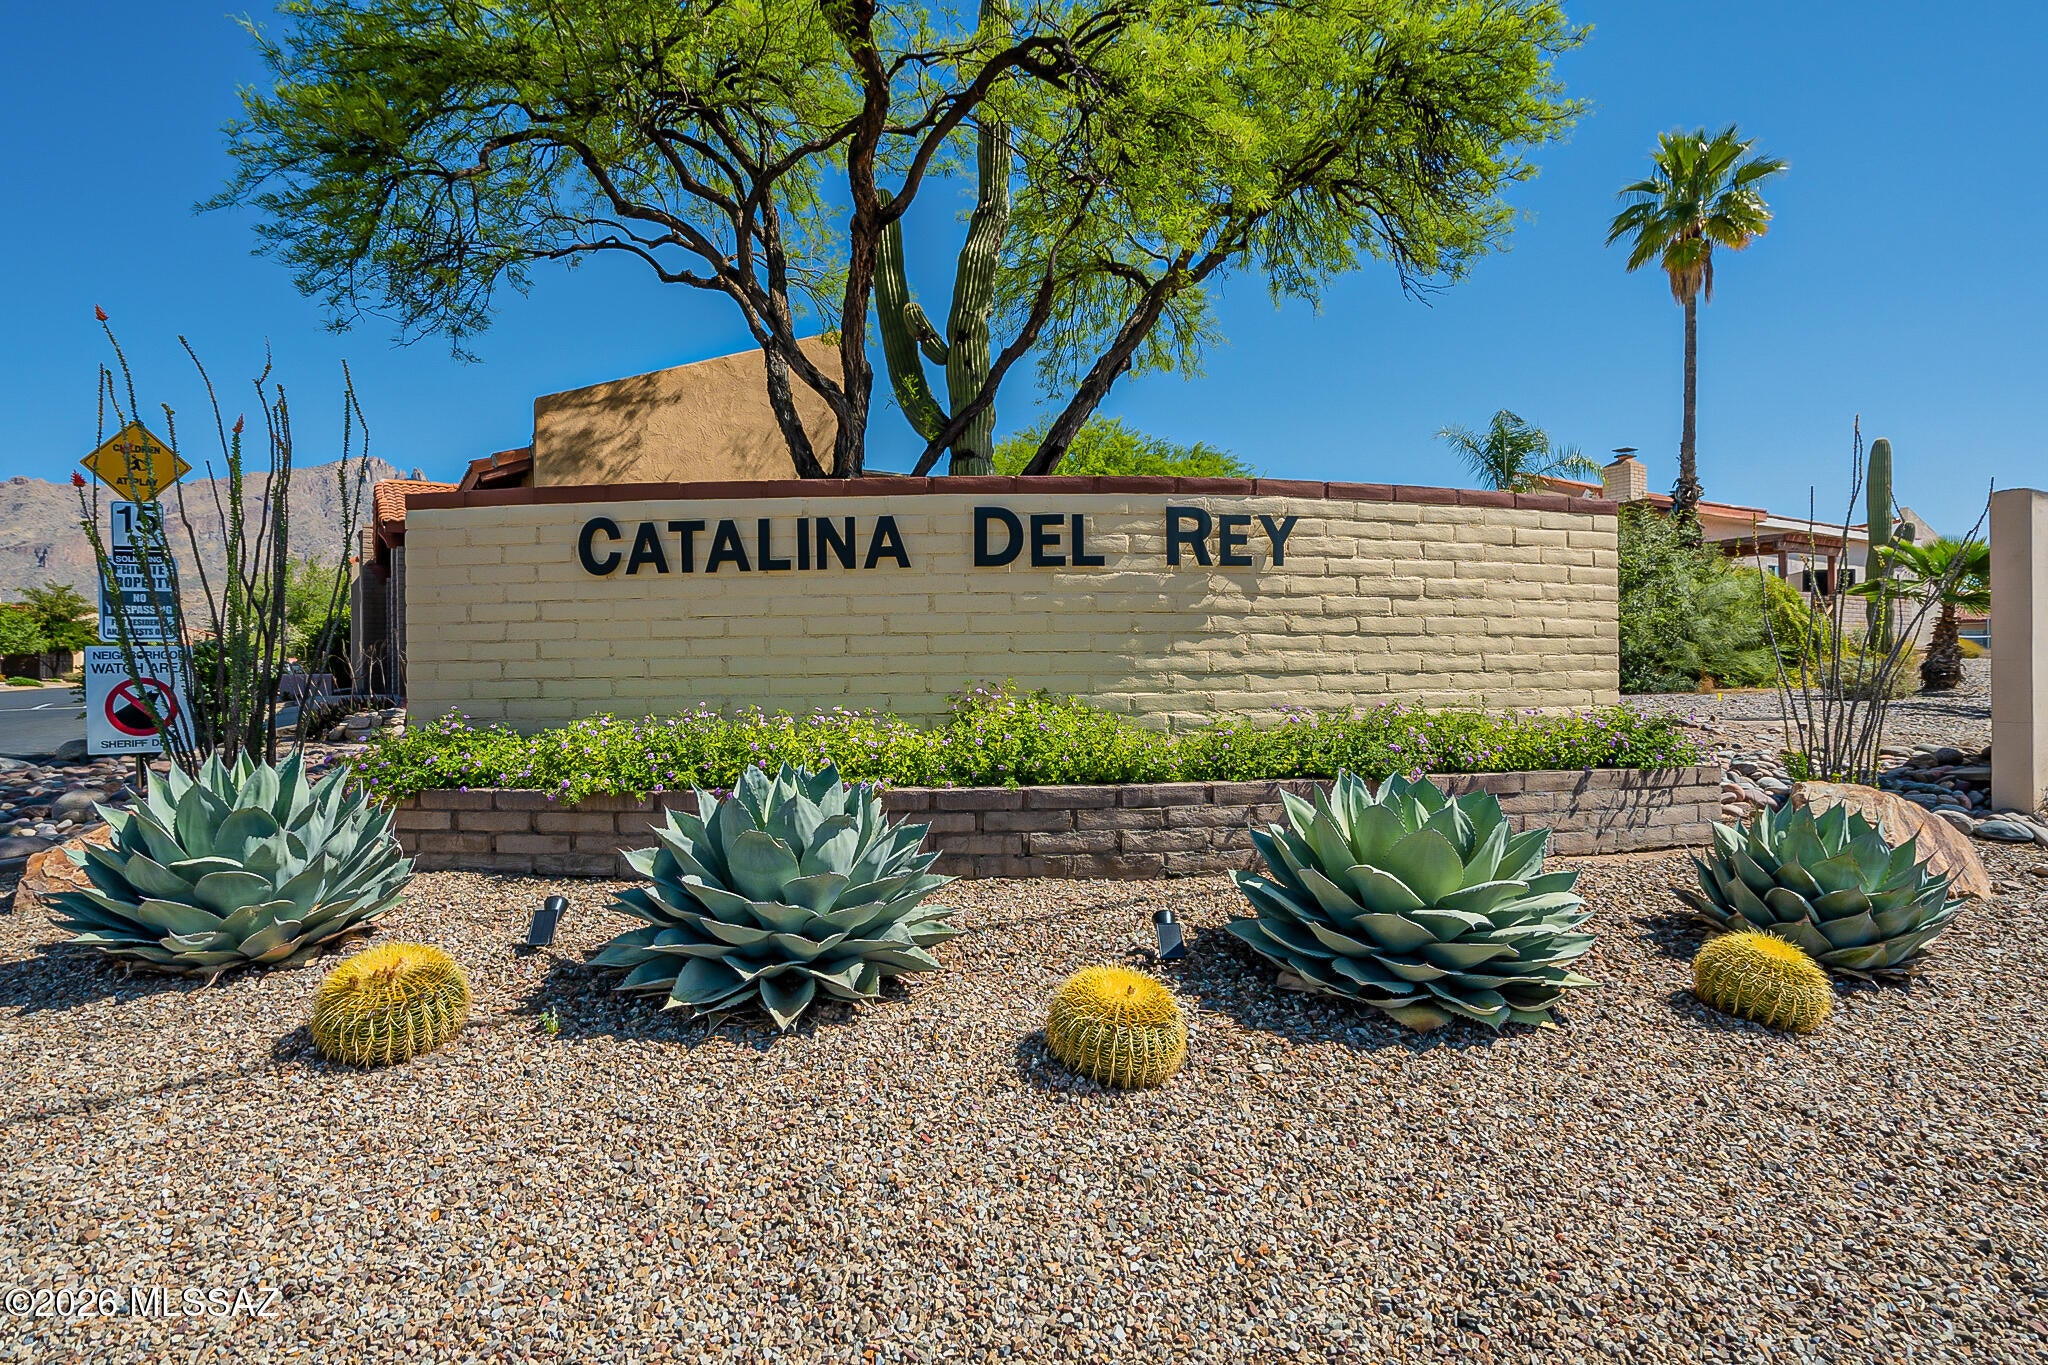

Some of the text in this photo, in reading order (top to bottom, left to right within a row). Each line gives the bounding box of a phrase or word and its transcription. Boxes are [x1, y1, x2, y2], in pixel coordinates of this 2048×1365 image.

[116, 477, 129, 485] AT
[116, 505, 158, 536] 15
[577, 506, 1300, 576] CATALINA DEL REY
[133, 594, 147, 603] NO
[101, 739, 148, 749] SHERIFF
